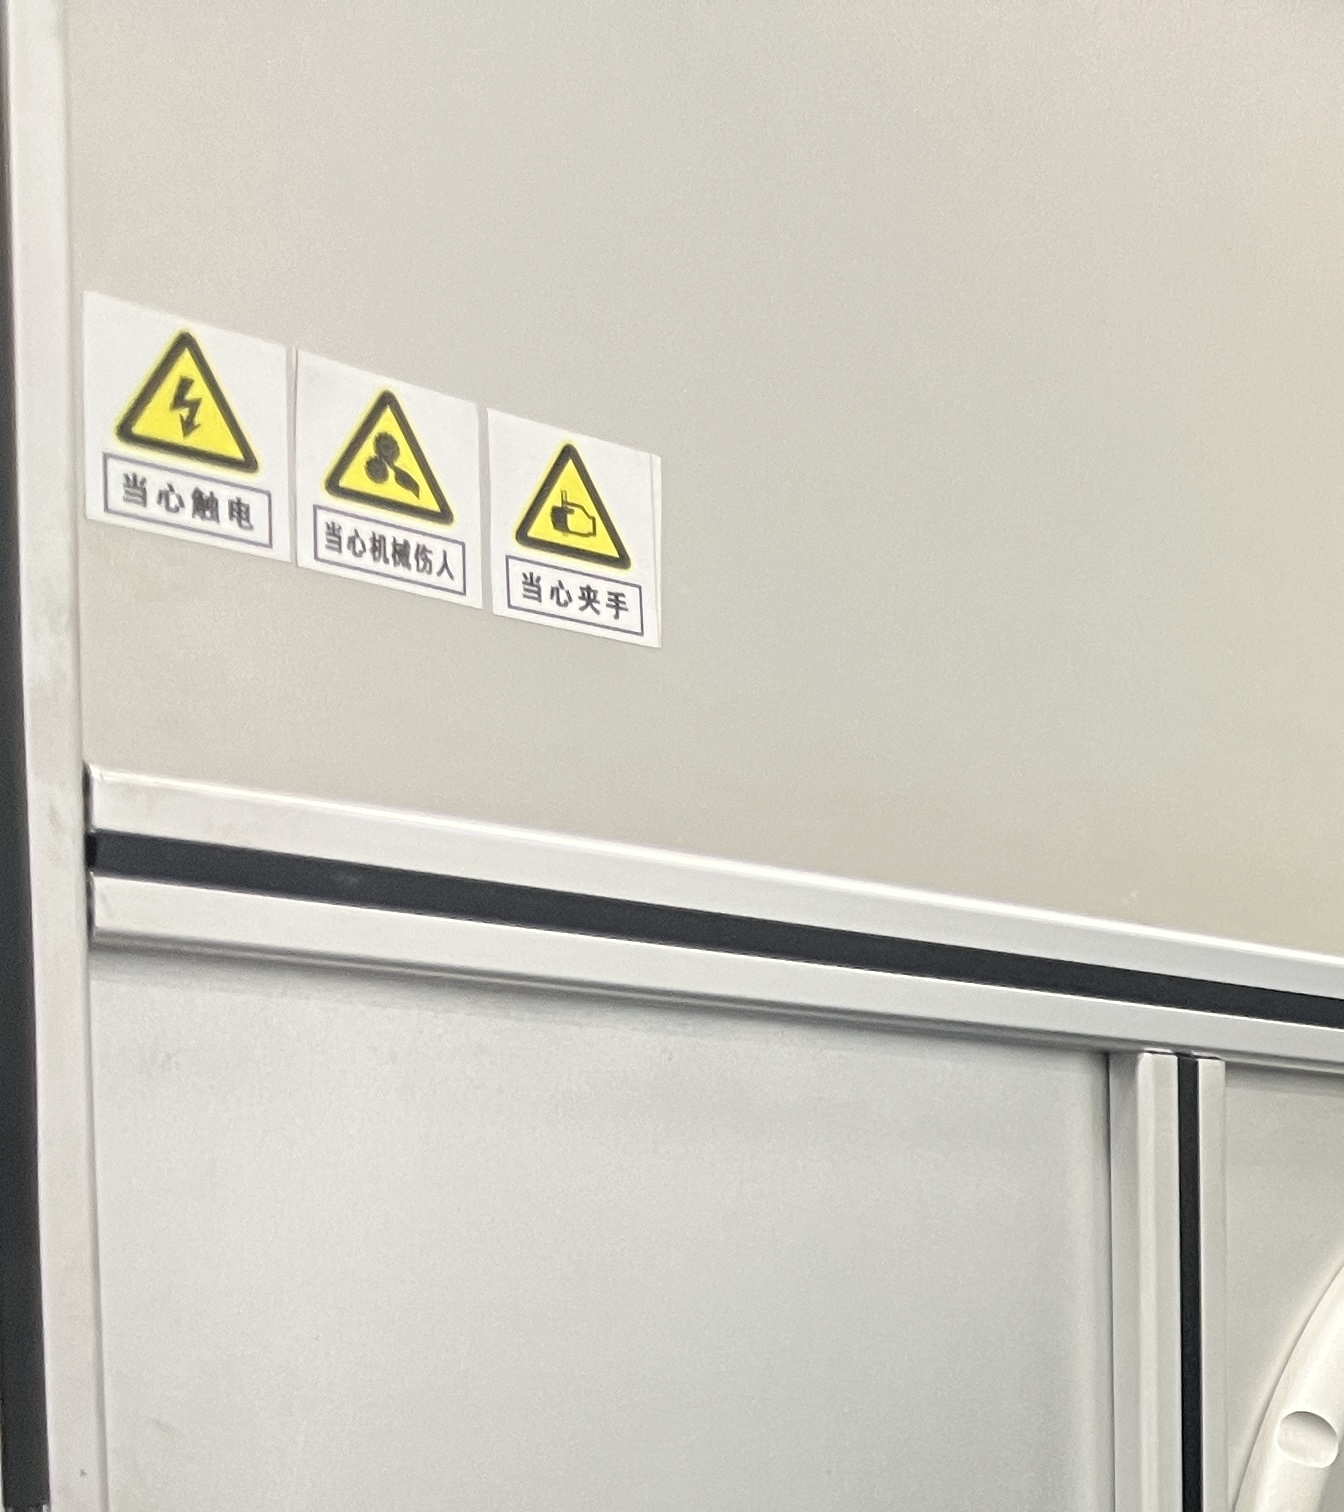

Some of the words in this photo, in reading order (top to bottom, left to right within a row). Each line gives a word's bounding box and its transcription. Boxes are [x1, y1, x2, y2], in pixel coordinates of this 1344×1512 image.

[122, 473, 254, 531] 当心触电
[324, 520, 455, 583] 当心机械伤人
[520, 570, 630, 620] 当心夹手
